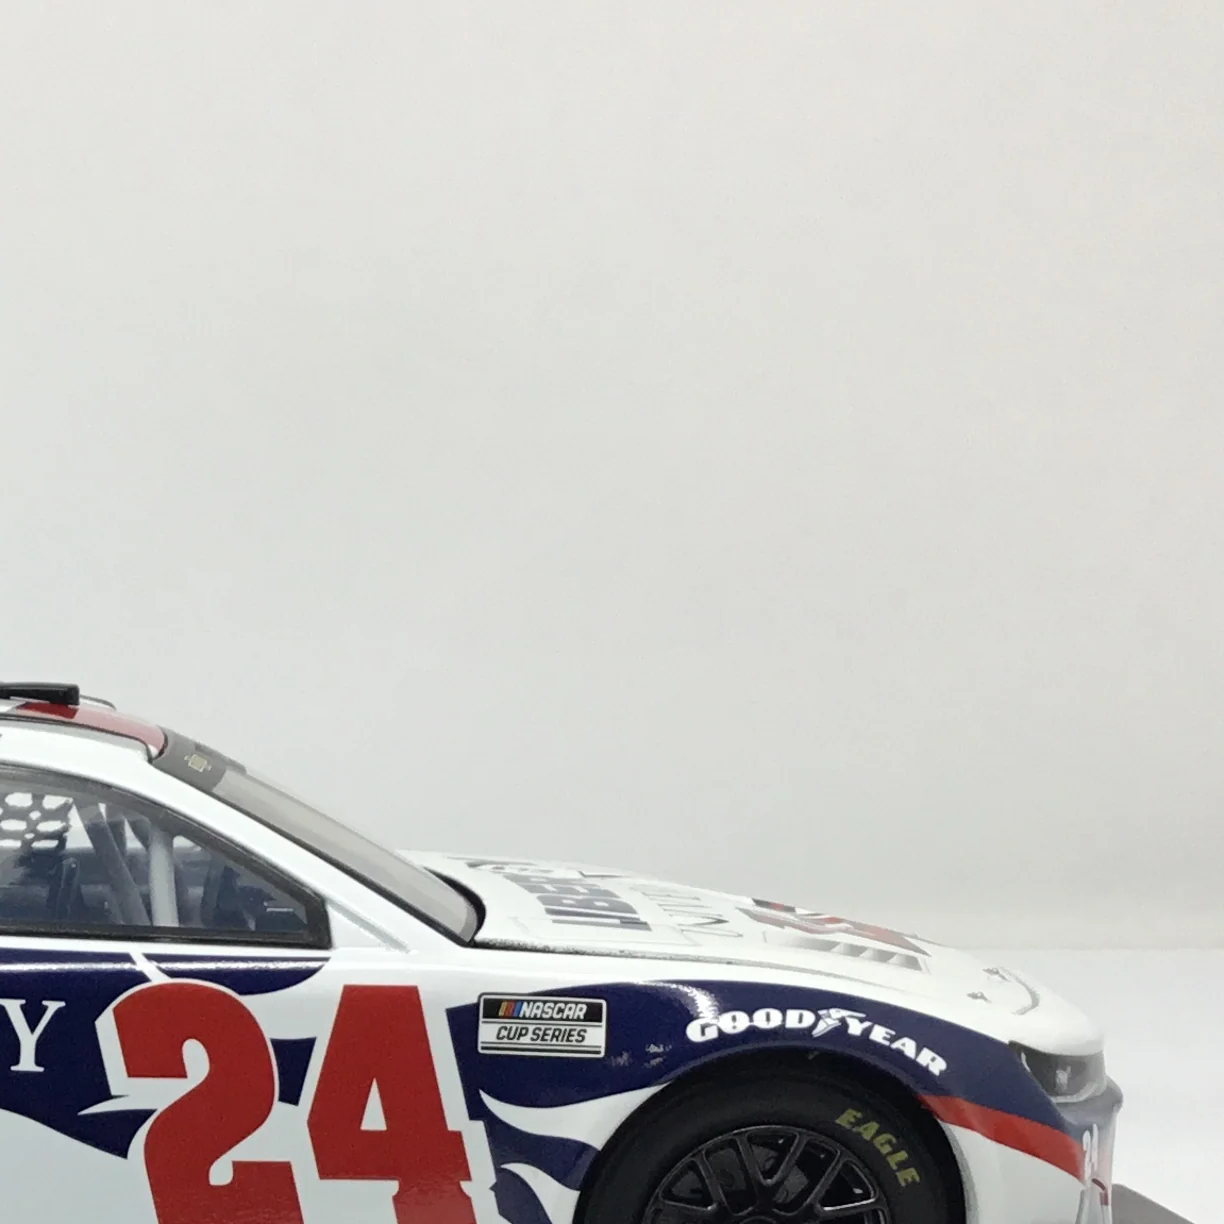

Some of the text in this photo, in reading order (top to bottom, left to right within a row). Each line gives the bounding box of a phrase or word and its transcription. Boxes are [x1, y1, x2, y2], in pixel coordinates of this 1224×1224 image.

[518, 1001, 588, 1020] NASCAR
[495, 1026, 588, 1044] CUP SERIES
[835, 1108, 921, 1187] EAGLE
